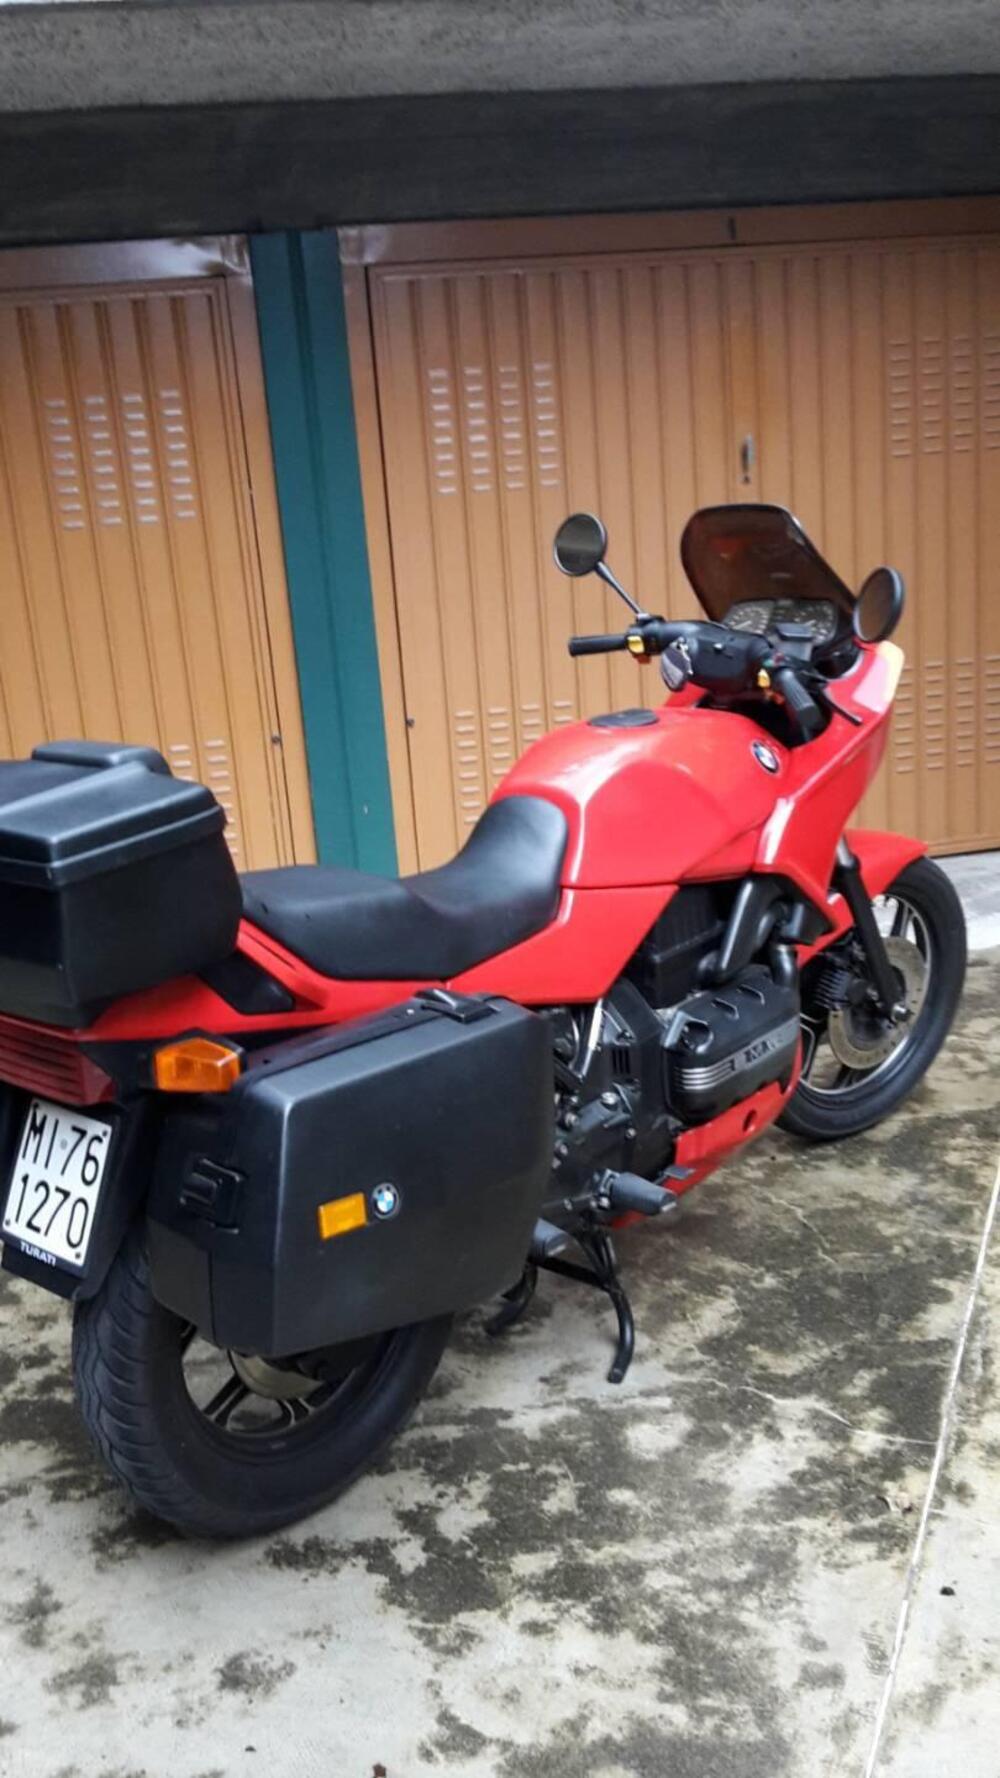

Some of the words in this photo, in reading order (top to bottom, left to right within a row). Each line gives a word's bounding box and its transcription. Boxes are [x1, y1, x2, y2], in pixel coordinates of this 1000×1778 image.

[22, 1109, 59, 1170] MI
[61, 1125, 104, 1186] 76
[15, 1173, 89, 1248] 1270
[20, 1241, 57, 1267] TURATI
